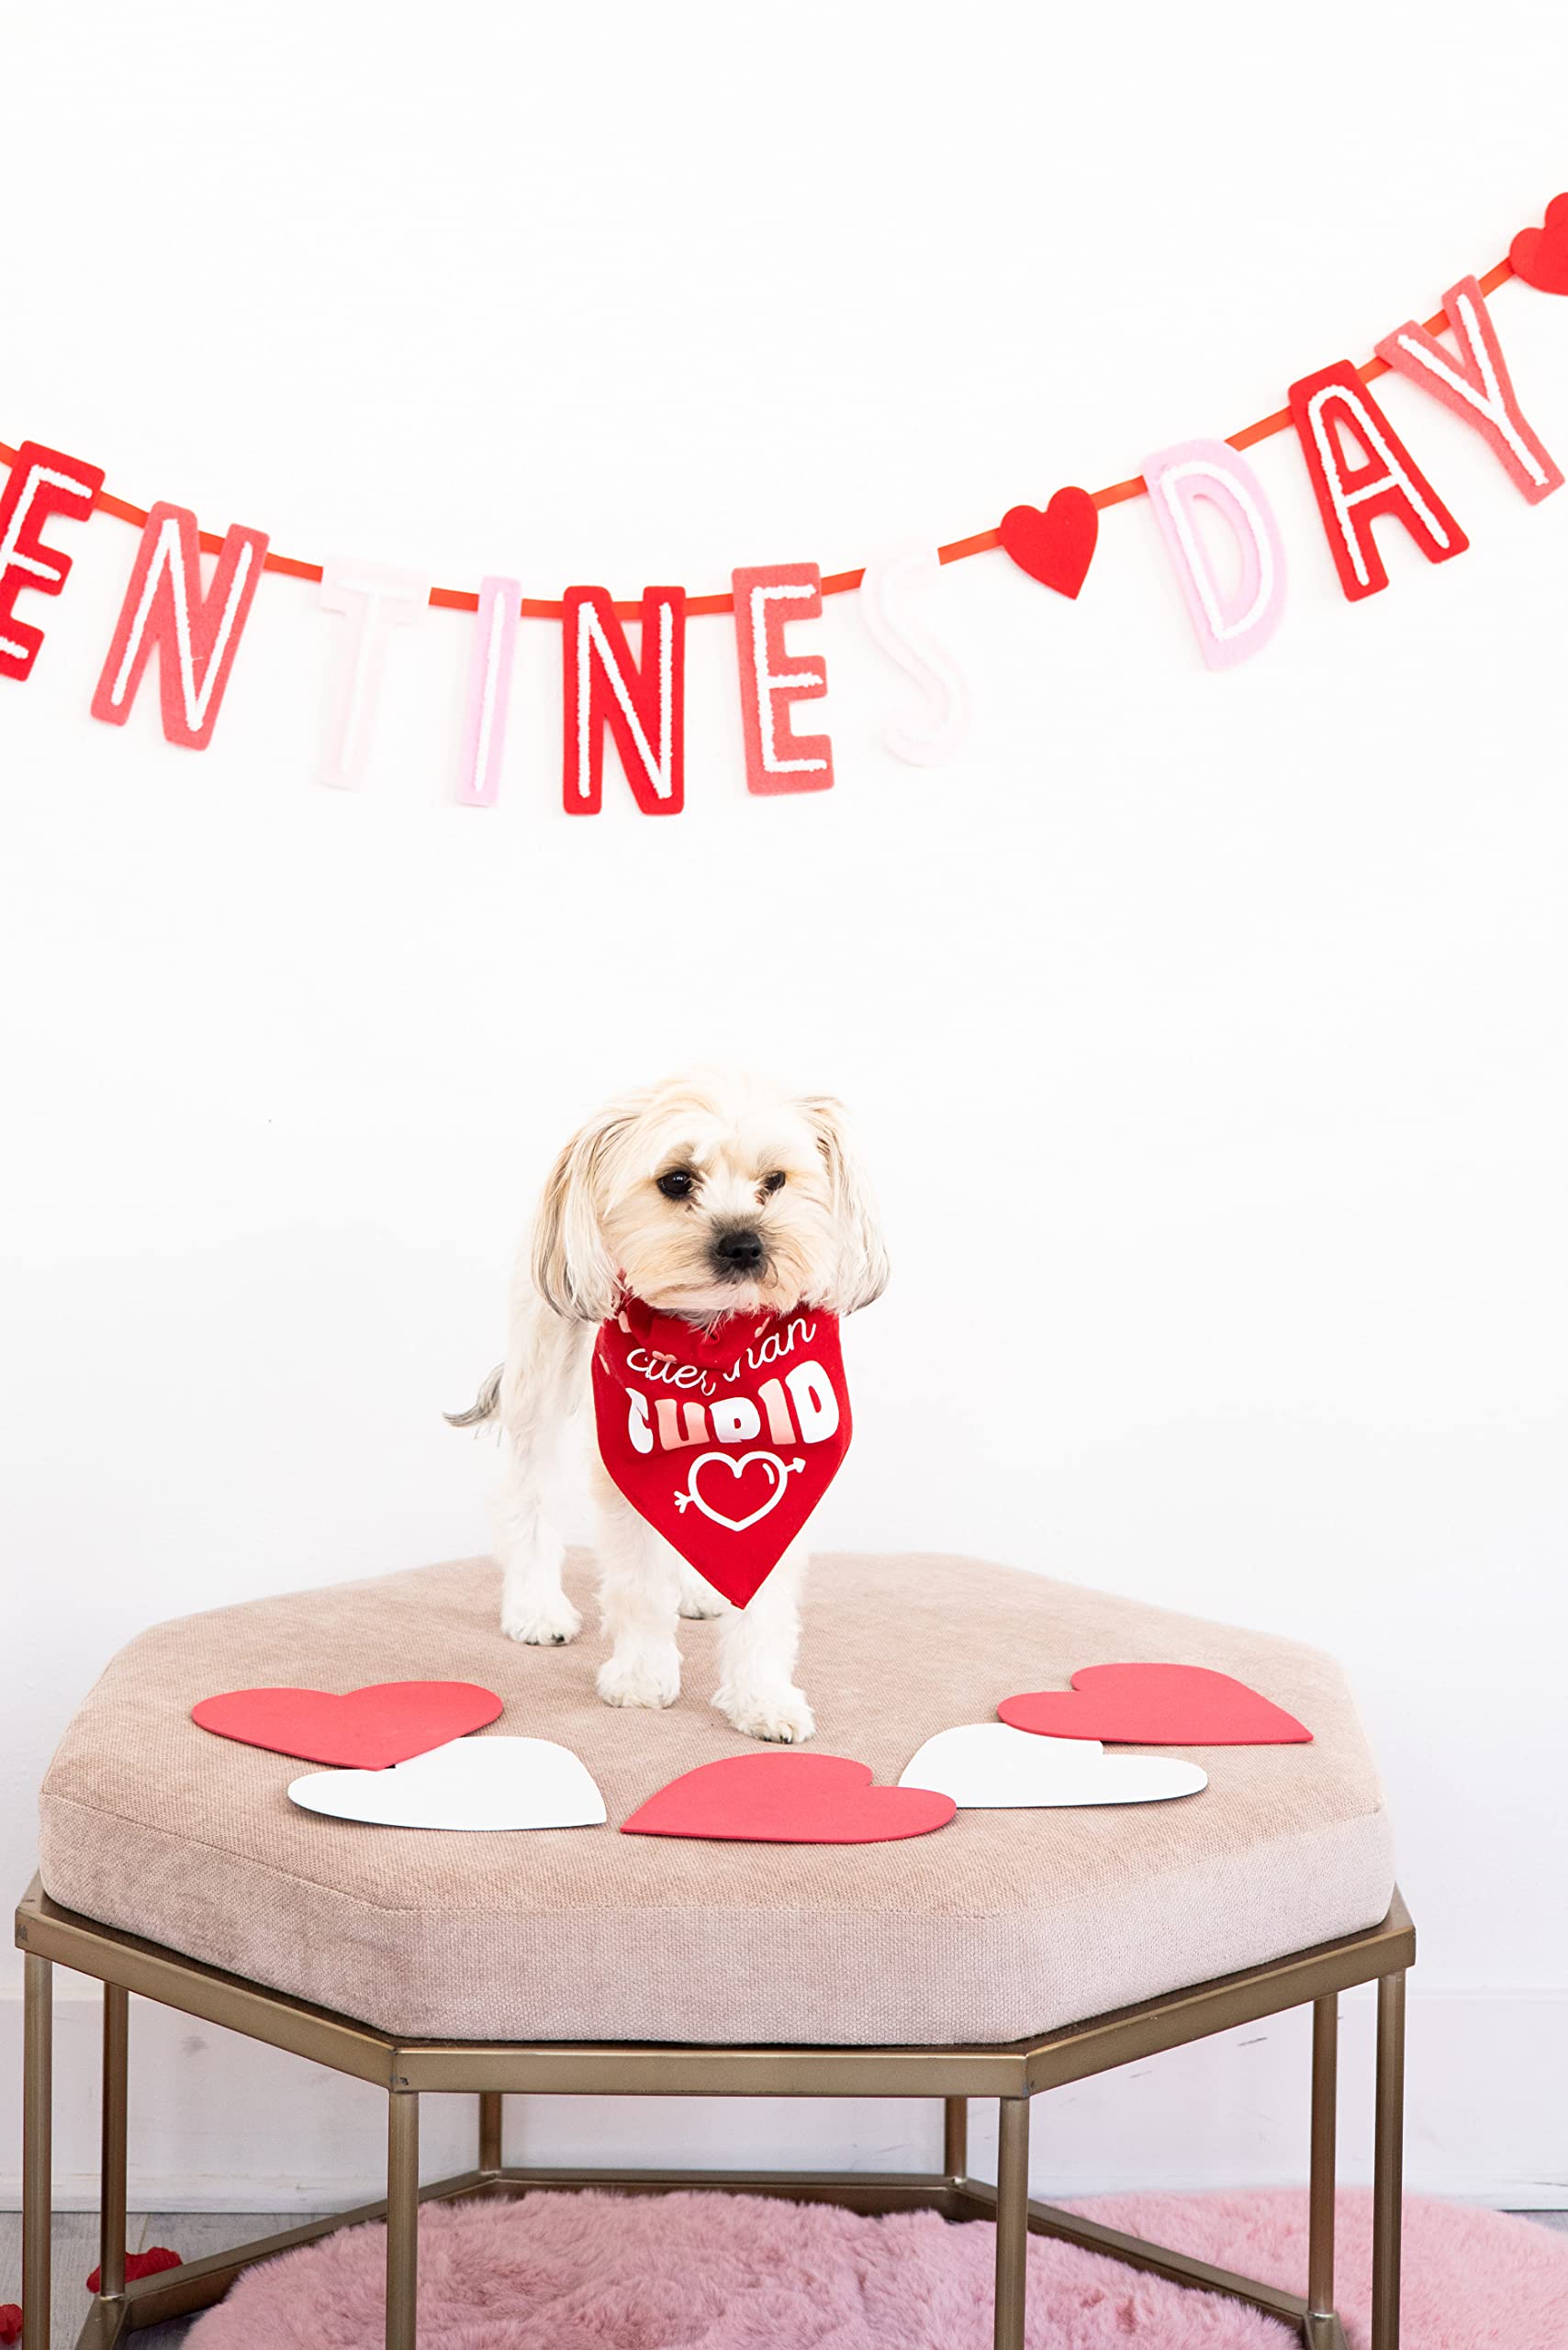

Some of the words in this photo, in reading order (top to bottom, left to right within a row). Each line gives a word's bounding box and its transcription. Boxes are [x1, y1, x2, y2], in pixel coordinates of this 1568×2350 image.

[1140, 274, 1565, 672] DAY
[722, 1317, 817, 1382] an
[625, 1360, 840, 1454] CUPID
